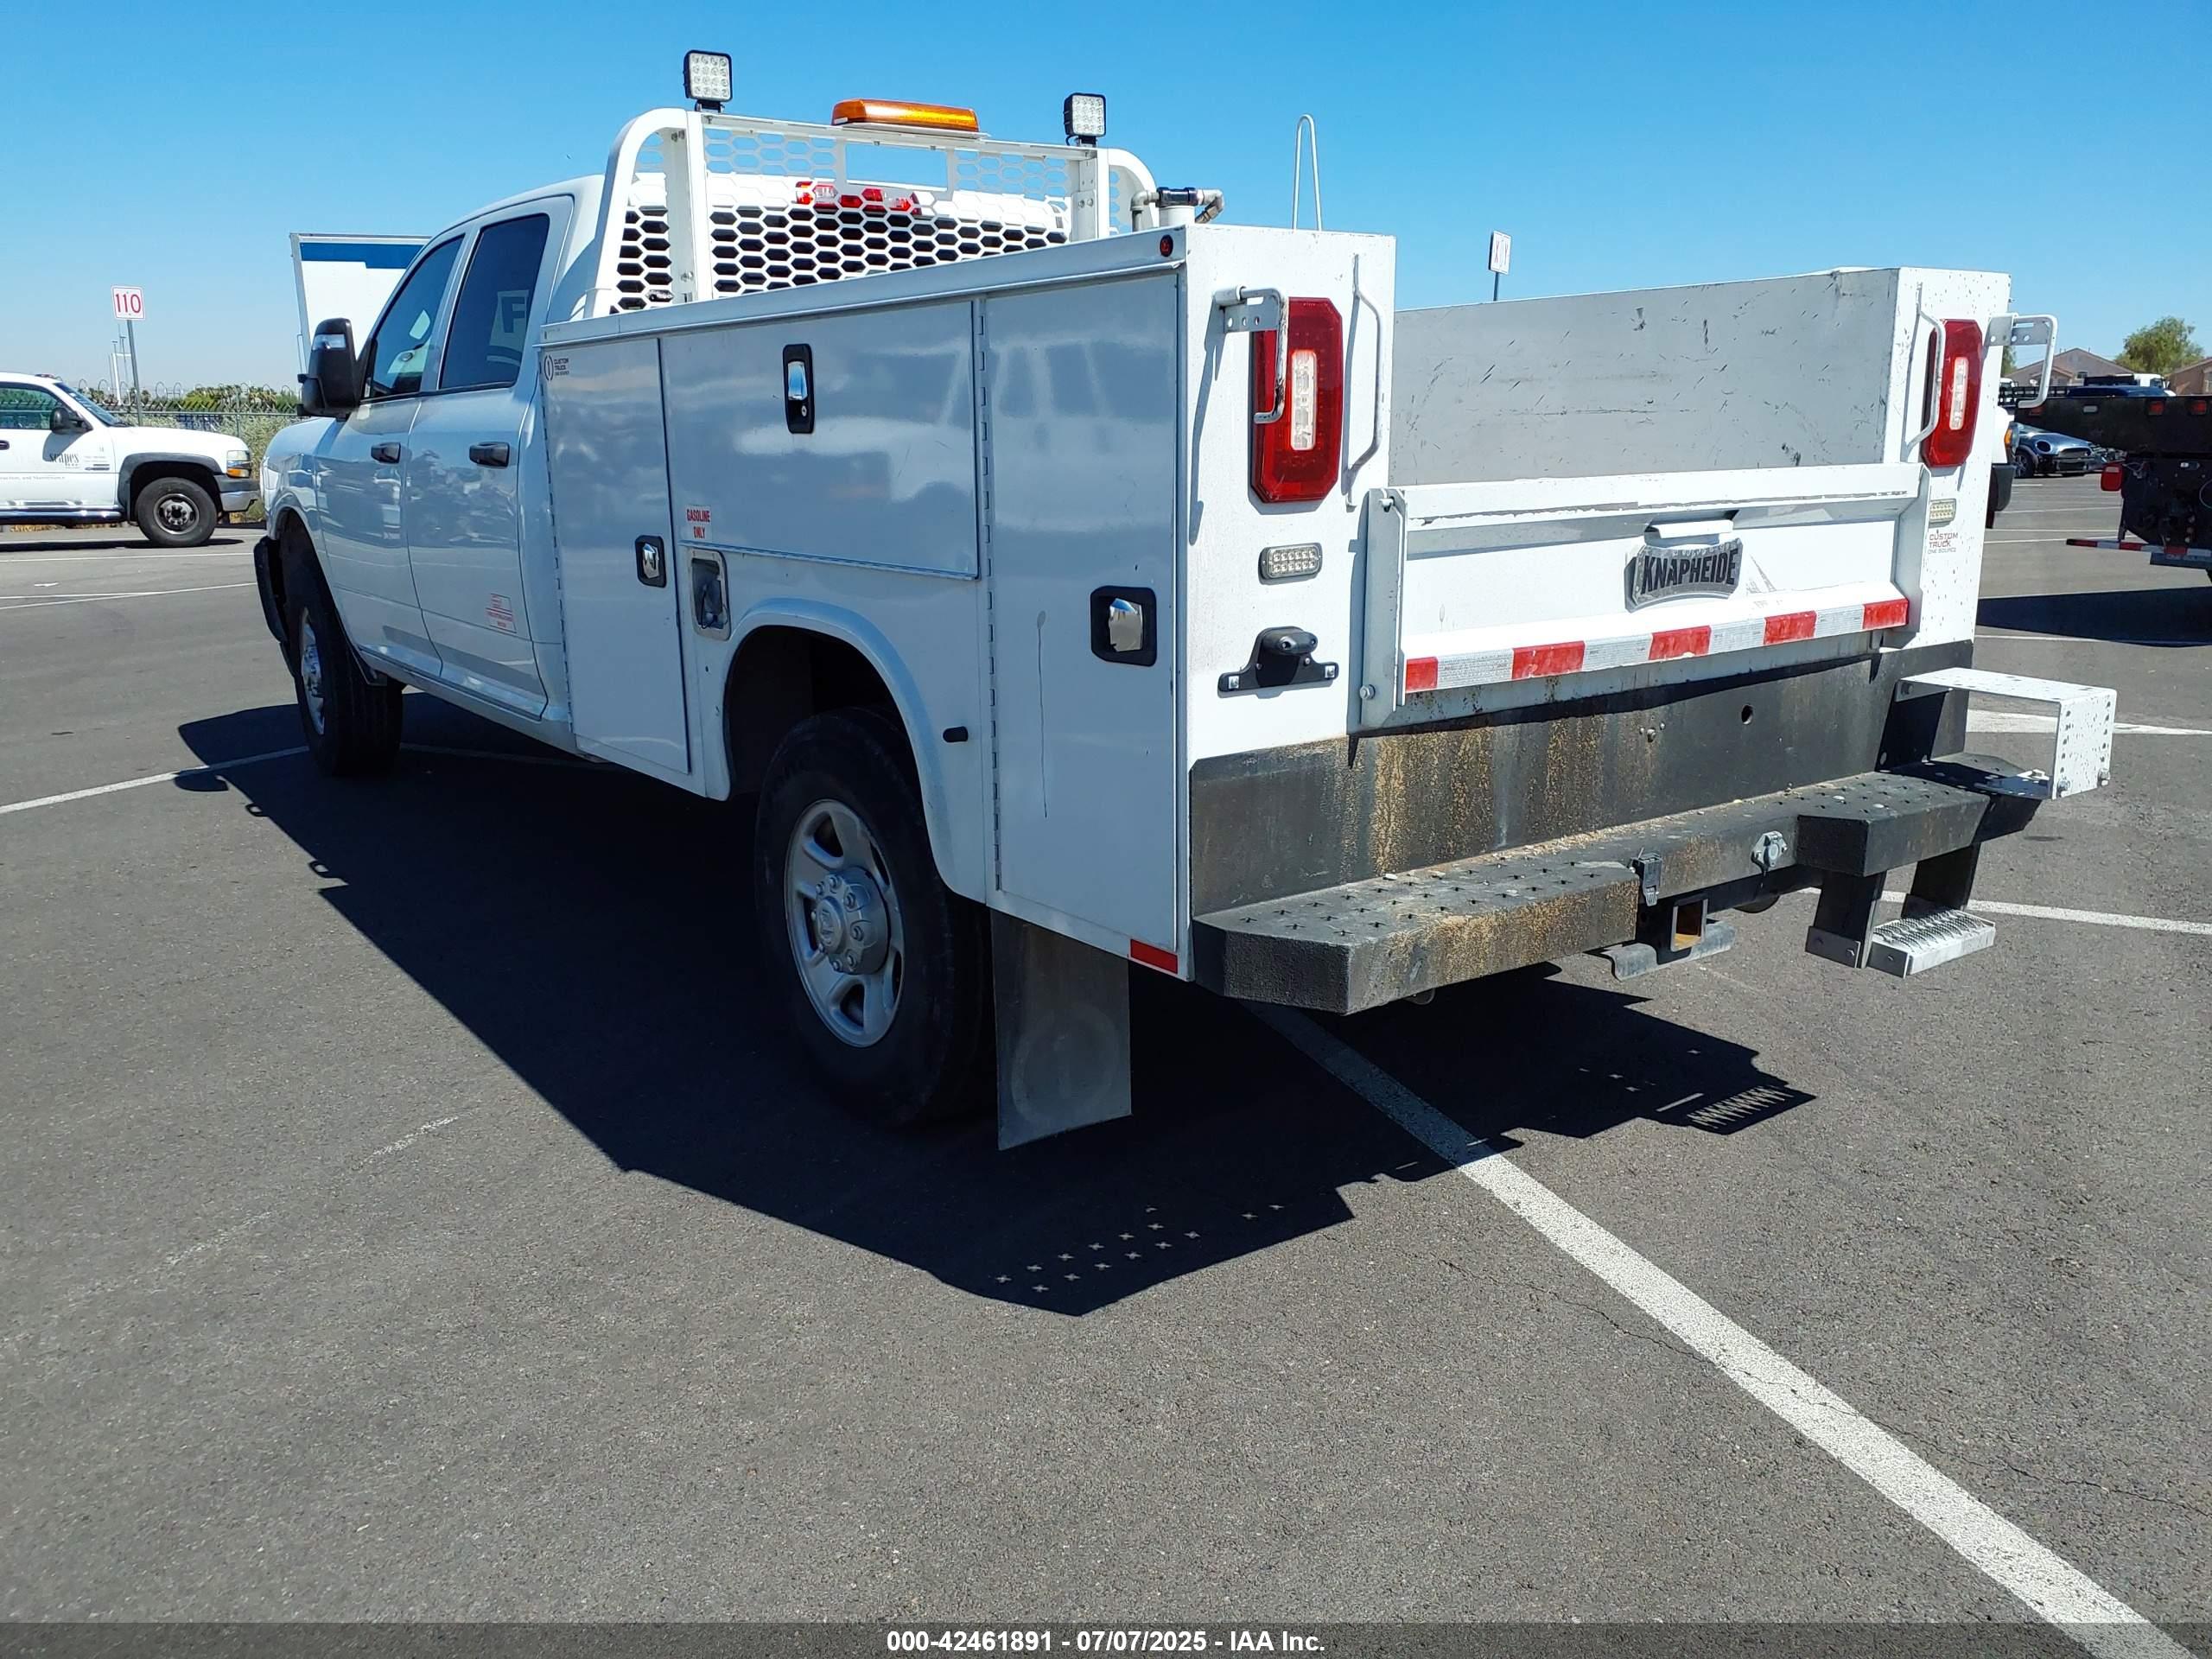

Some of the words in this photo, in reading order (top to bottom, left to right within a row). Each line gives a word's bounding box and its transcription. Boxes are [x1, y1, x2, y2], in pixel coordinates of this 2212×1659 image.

[115, 293, 142, 314] 110
[686, 509, 710, 523] GASOLINE
[693, 526, 705, 539] ONLY
[1929, 532, 1959, 541] CUSTOM
[1929, 539, 1951, 549] TRUCK
[1640, 549, 1738, 595] KNAPHEIDE
